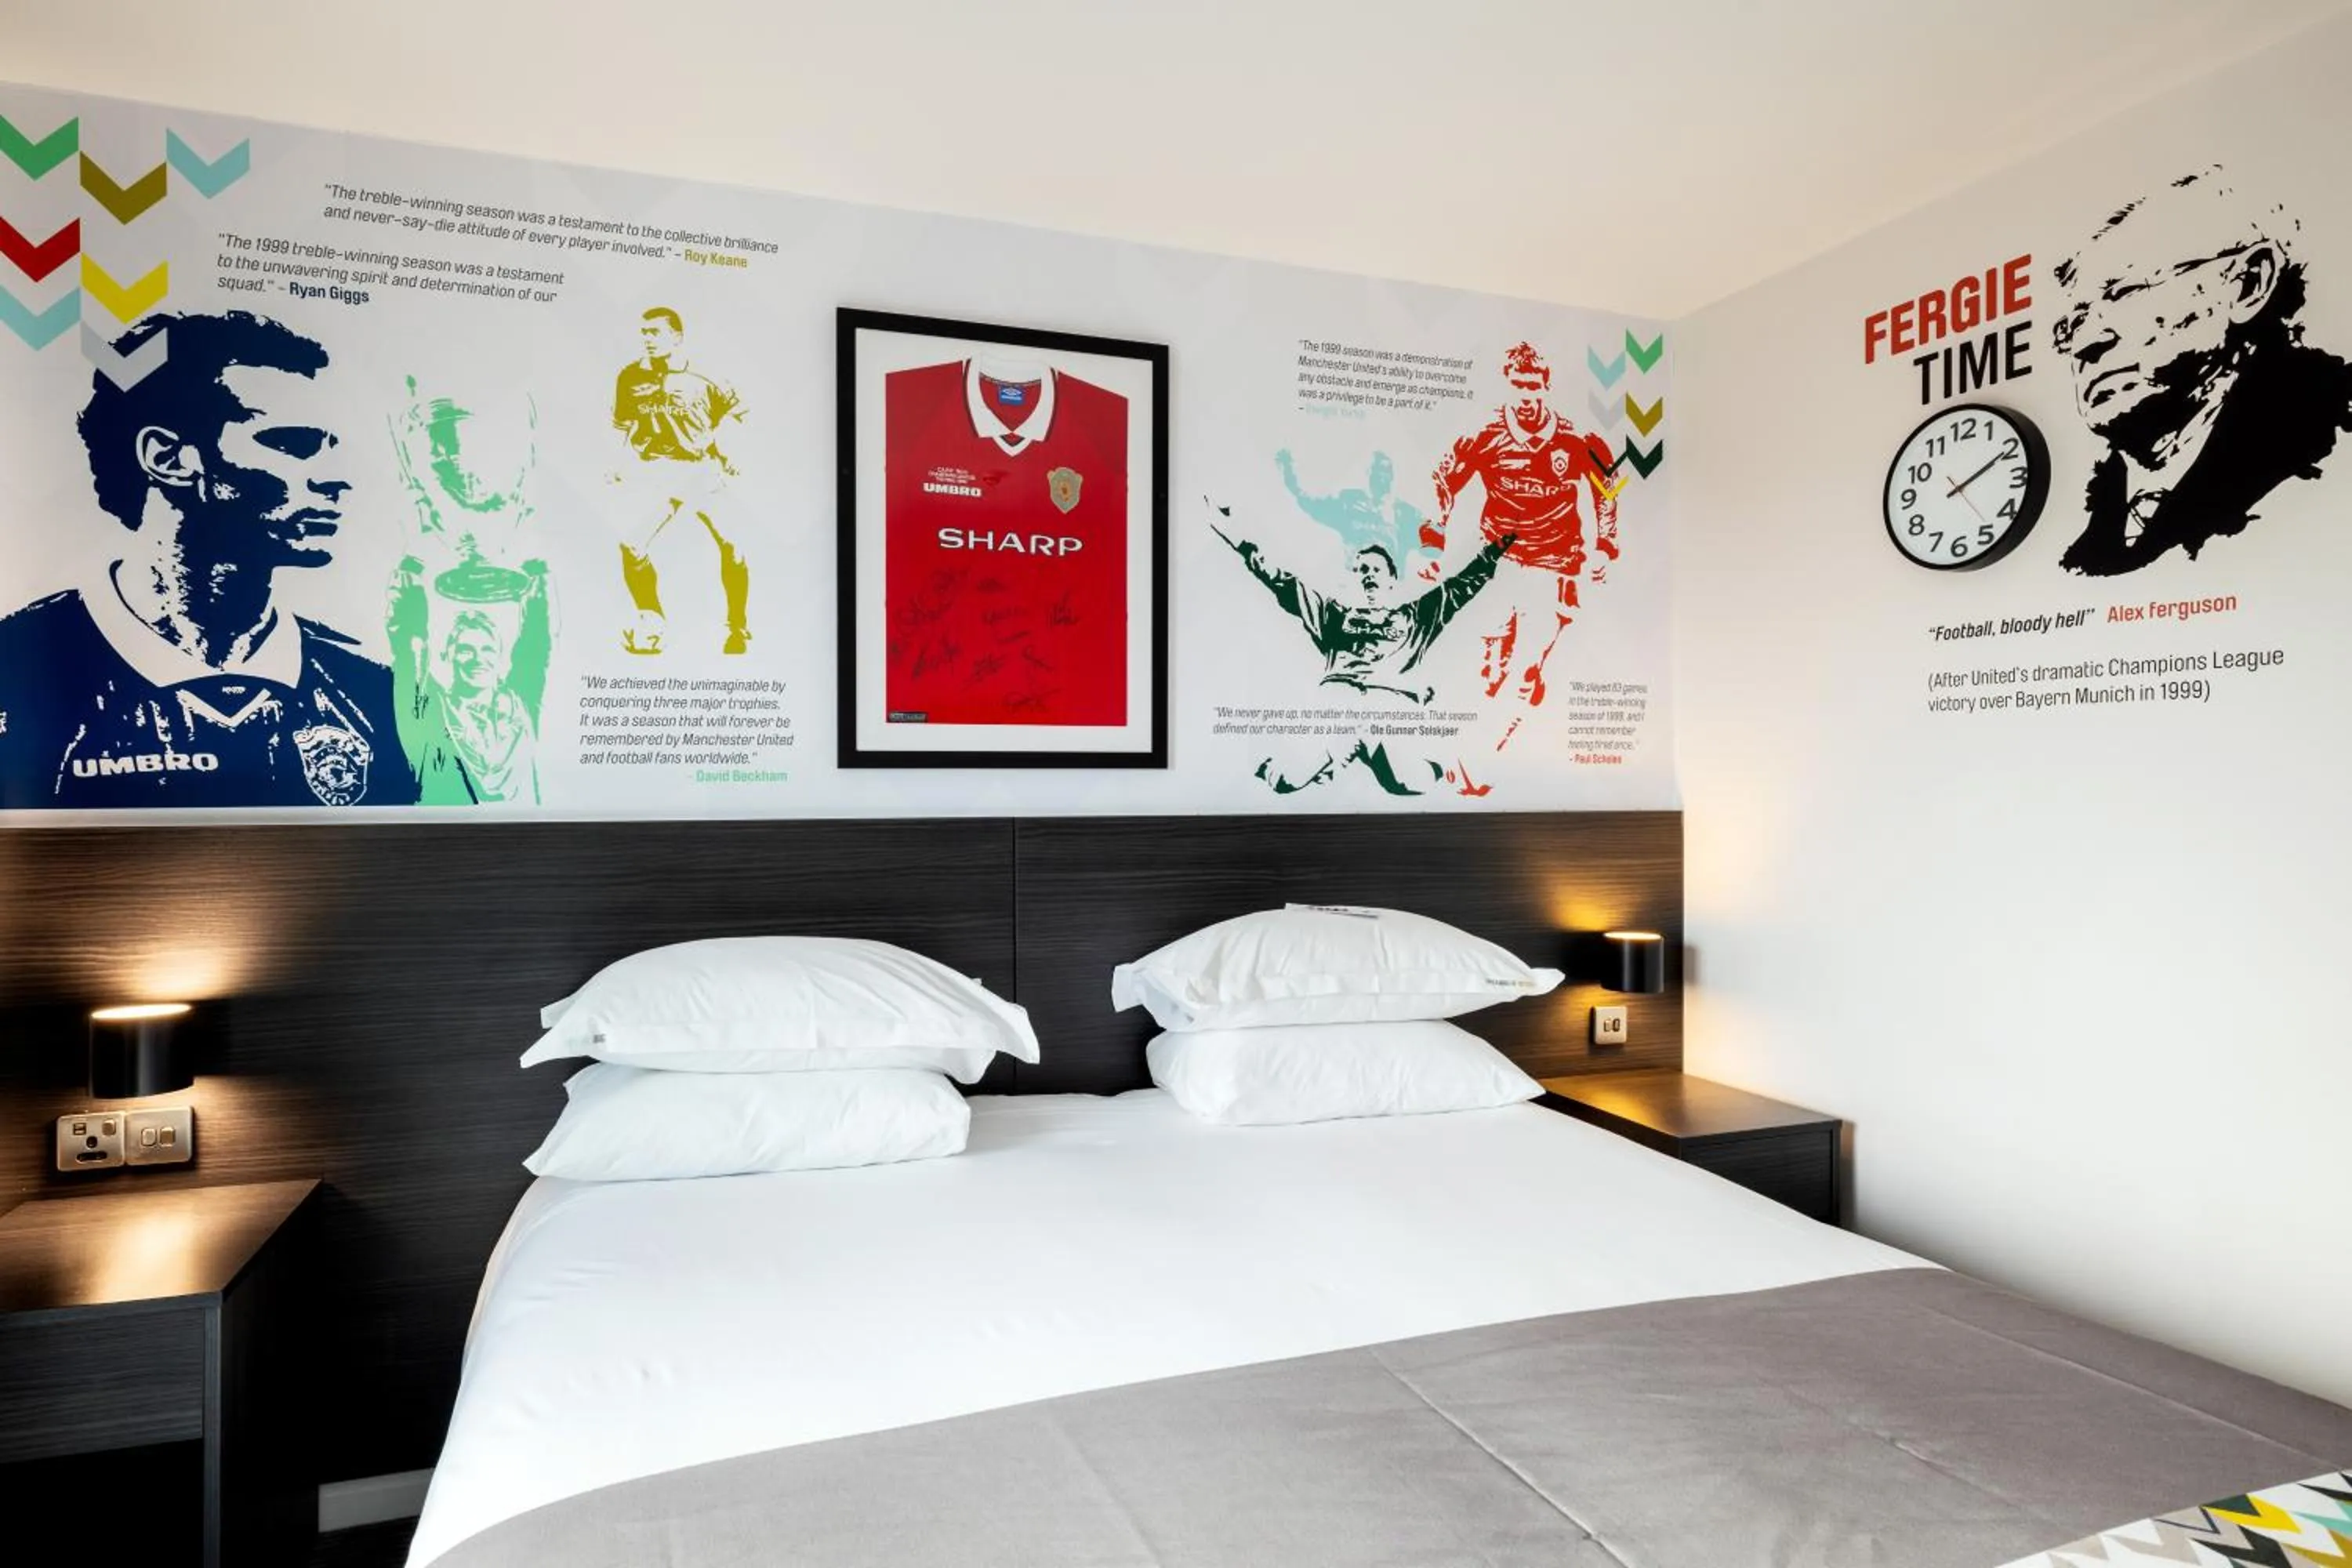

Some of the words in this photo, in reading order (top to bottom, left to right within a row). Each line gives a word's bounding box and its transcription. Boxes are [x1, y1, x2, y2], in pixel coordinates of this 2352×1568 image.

[358, 188, 465, 217] treble-winning
[464, 204, 515, 220] season
[517, 211, 546, 225] was
[546, 215, 557, 226] a
[557, 213, 625, 234] testament
[626, 222, 640, 236] to
[640, 225, 662, 239] the
[663, 229, 722, 247] collective
[723, 235, 779, 253] brilliance
[323, 206, 351, 220] and
[352, 209, 456, 233] never-say-die
[456, 221, 510, 239] attitude
[511, 228, 527, 241] of
[528, 231, 568, 249] every
[567, 235, 611, 252] player
[684, 248, 708, 266] Roy
[706, 251, 748, 268] Keane
[256, 238, 290, 255] 1999
[292, 241, 399, 270] treble-winning
[401, 256, 452, 272] season
[454, 263, 484, 276] was
[485, 266, 495, 277] a
[496, 265, 564, 285] testament
[216, 253, 233, 268] to
[234, 255, 260, 271] the
[262, 261, 349, 285] unwavering
[350, 270, 389, 285] spirit
[390, 275, 418, 288] and
[419, 276, 515, 298] determination
[517, 288, 532, 300] of
[533, 290, 557, 302] our
[289, 281, 326, 299] Ryan
[328, 285, 369, 306] Giggs
[1865, 254, 2032, 365] FERGIE
[1913, 320, 2033, 405] TIME
[1950, 417, 1976, 442] 12
[1984, 420, 1994, 441] 1
[1925, 436, 1945, 458] 11
[2001, 437, 2019, 460] 2
[1907, 462, 1933, 484] 10
[2009, 466, 2028, 488] 3
[924, 482, 982, 497] UMBRO
[1900, 488, 1917, 510] 9
[1996, 498, 2017, 521] 4
[1907, 514, 1925, 536] 8
[1977, 524, 1994, 546] 5
[938, 528, 1083, 556] SHARP
[1929, 531, 1944, 553] 7
[1950, 535, 1968, 557] 6
[2107, 604, 2144, 623] Alex
[2148, 595, 2237, 621] ferguson
[1999, 614, 2053, 634] bloody
[1928, 672, 1969, 692] (After
[2032, 660, 2104, 681] dramatic
[2108, 654, 2207, 677] Champions
[2212, 649, 2284, 673] League
[609, 677, 666, 690] achieved
[667, 677, 688, 690] the
[690, 678, 770, 694] unimaginable
[771, 680, 786, 695] by
[1928, 695, 1976, 713] victory
[1979, 695, 2013, 710] over
[2015, 690, 2071, 710] Bayern
[2074, 684, 2135, 705] Munich
[2140, 684, 2155, 701] in
[2159, 679, 2210, 703] 1999)
[579, 695, 652, 712] conquering
[653, 695, 688, 709] three
[689, 697, 727, 712] major
[728, 697, 780, 712] trophies.
[592, 716, 619, 727] was
[620, 716, 630, 727] a
[631, 716, 677, 727] season
[678, 714, 704, 727] that
[706, 714, 728, 727] will
[728, 714, 775, 728] forever
[775, 716, 790, 728] be
[579, 733, 663, 746] remembered
[665, 733, 681, 748] by
[681, 732, 755, 746] Manchester
[757, 733, 794, 746] United
[73, 753, 219, 777] UMBRO
[579, 751, 604, 764] and
[606, 751, 653, 764] football
[655, 751, 682, 764] fans
[695, 769, 730, 782] David
[731, 769, 788, 782] Beckham
